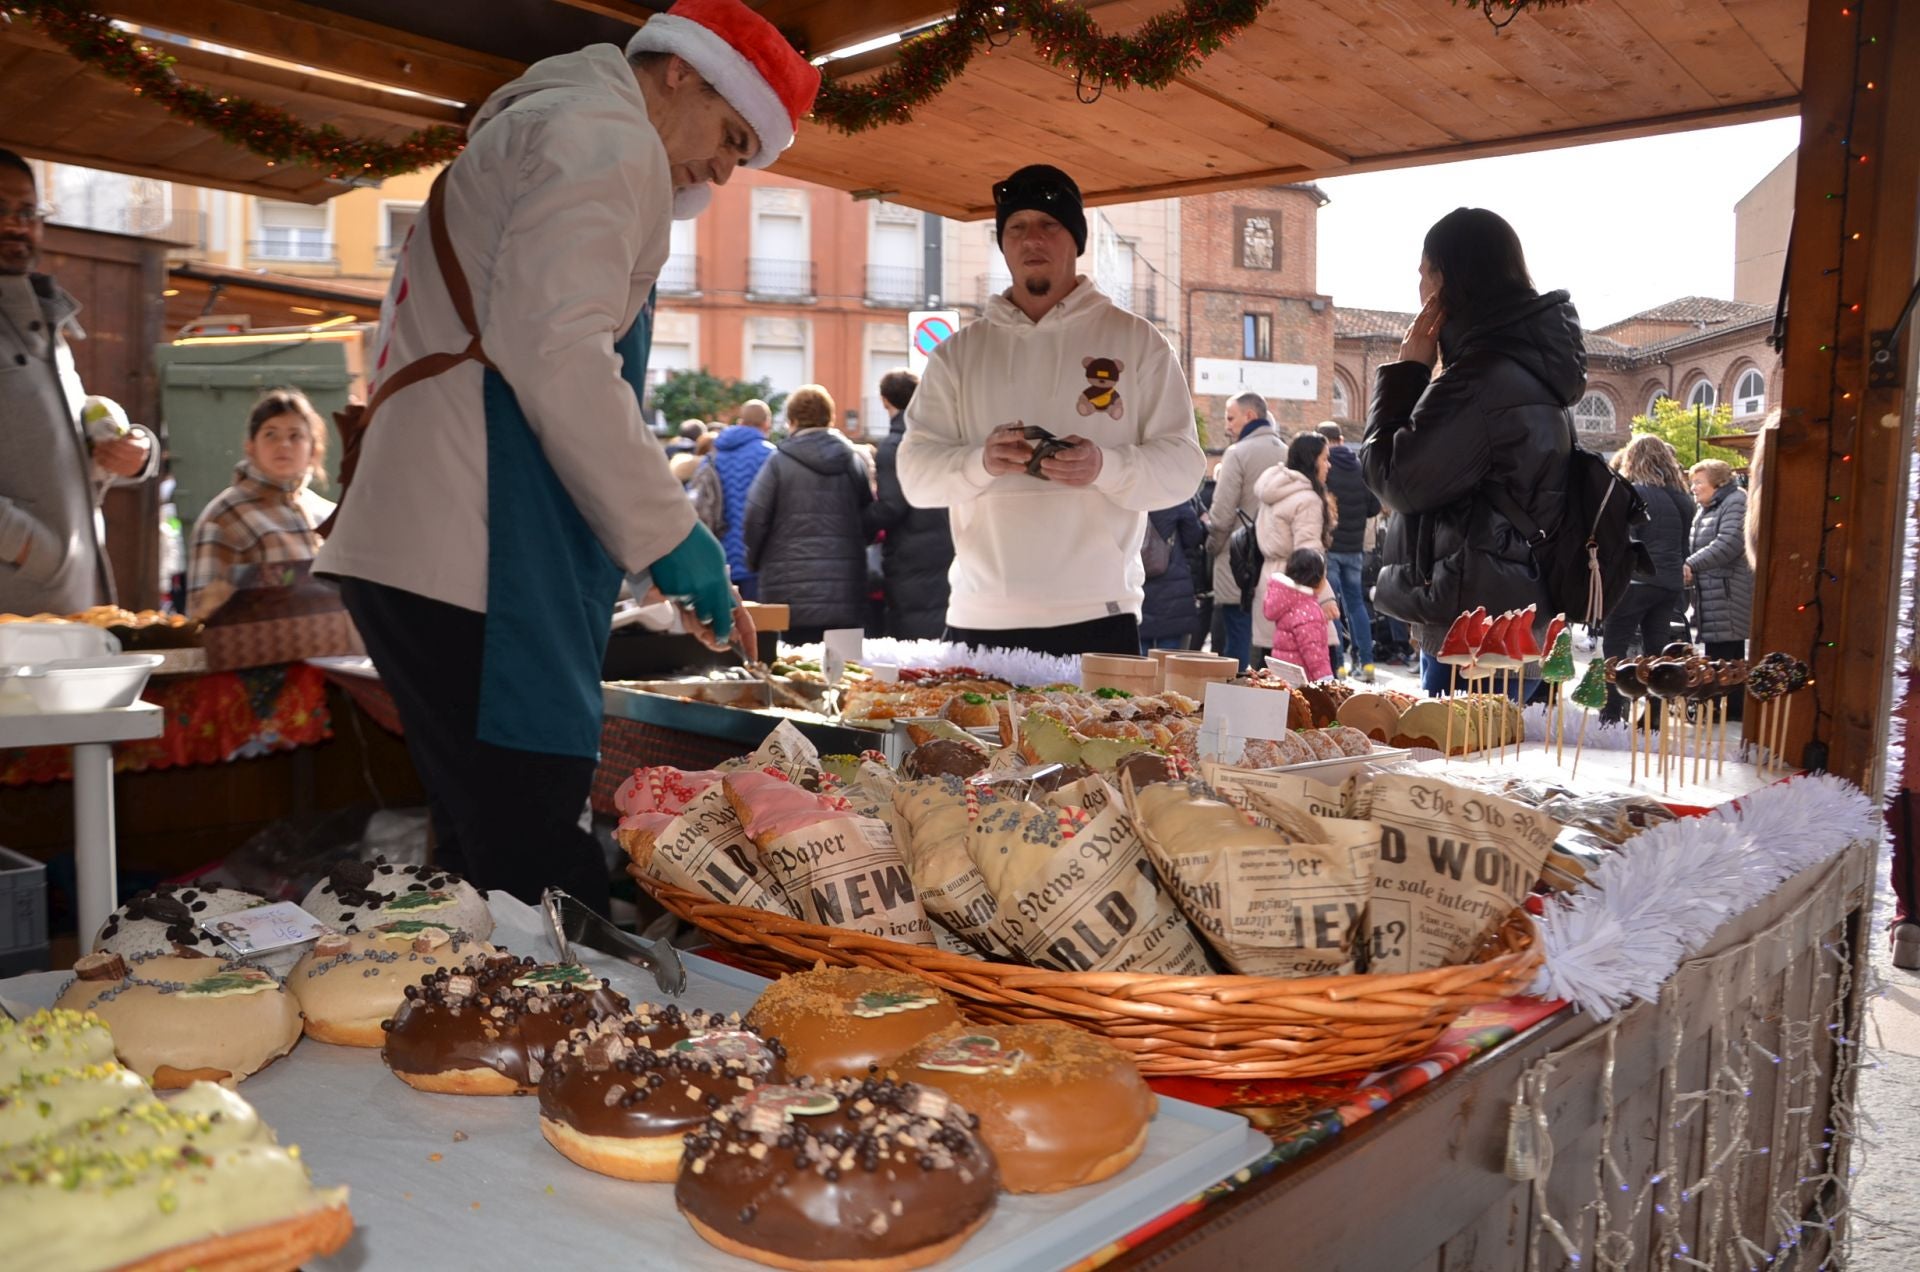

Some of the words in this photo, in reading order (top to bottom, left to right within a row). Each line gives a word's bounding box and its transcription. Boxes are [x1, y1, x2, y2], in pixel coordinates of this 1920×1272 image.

[1408, 784, 1455, 818] The
[1462, 799, 1506, 829] Old
[770, 832, 846, 880] Paper
[810, 864, 916, 928] NEW
[1017, 858, 1087, 924] News
[1396, 879, 1435, 898] sale
